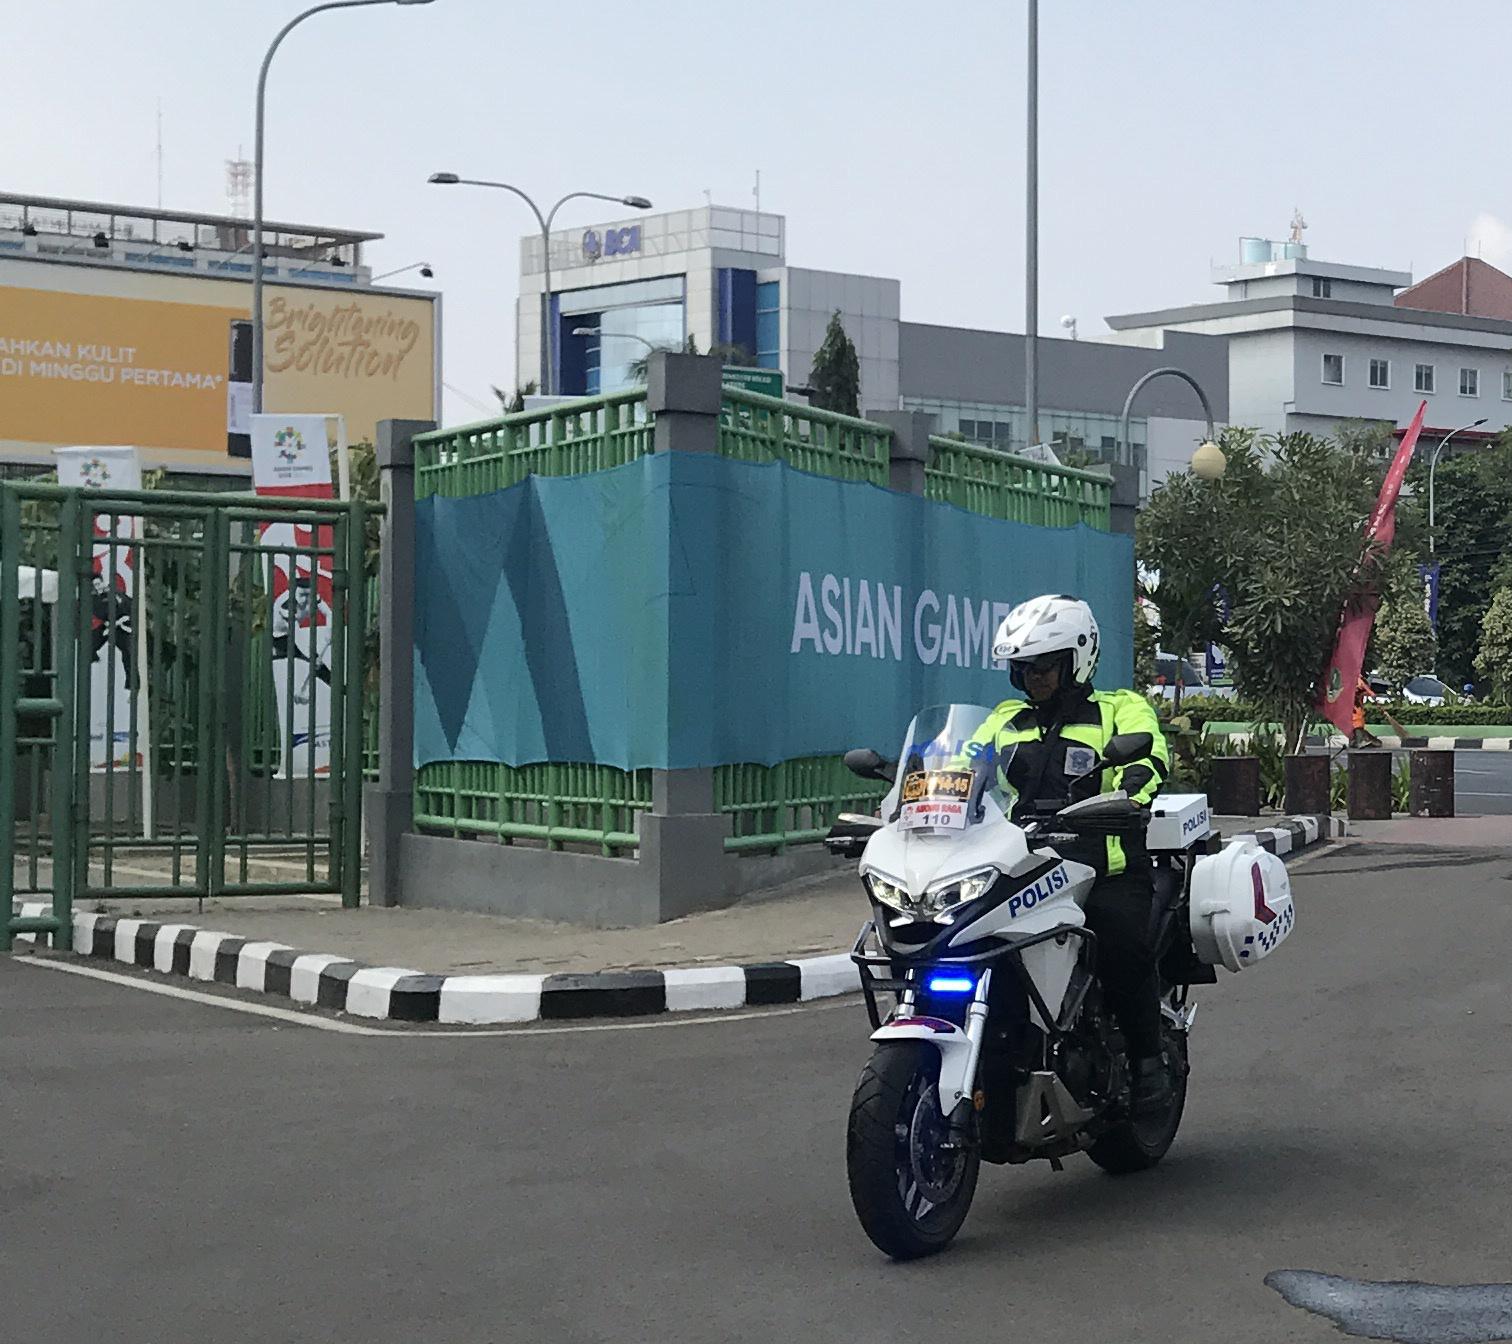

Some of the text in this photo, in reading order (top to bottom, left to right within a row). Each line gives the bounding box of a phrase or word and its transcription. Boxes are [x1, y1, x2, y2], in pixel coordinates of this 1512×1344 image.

[604, 225, 641, 256] BCA
[265, 297, 420, 362] Brightening
[77, 344, 137, 364] KULIT
[265, 330, 404, 382] Solution
[1, 358, 23, 376] DI
[29, 360, 115, 384] MINGGU
[790, 572, 1009, 671] ASIAN GAME
[905, 740, 994, 764] POLISI
[922, 814, 951, 826] 110
[1183, 809, 1207, 836] POLISI
[1008, 866, 1069, 919] POLISI
